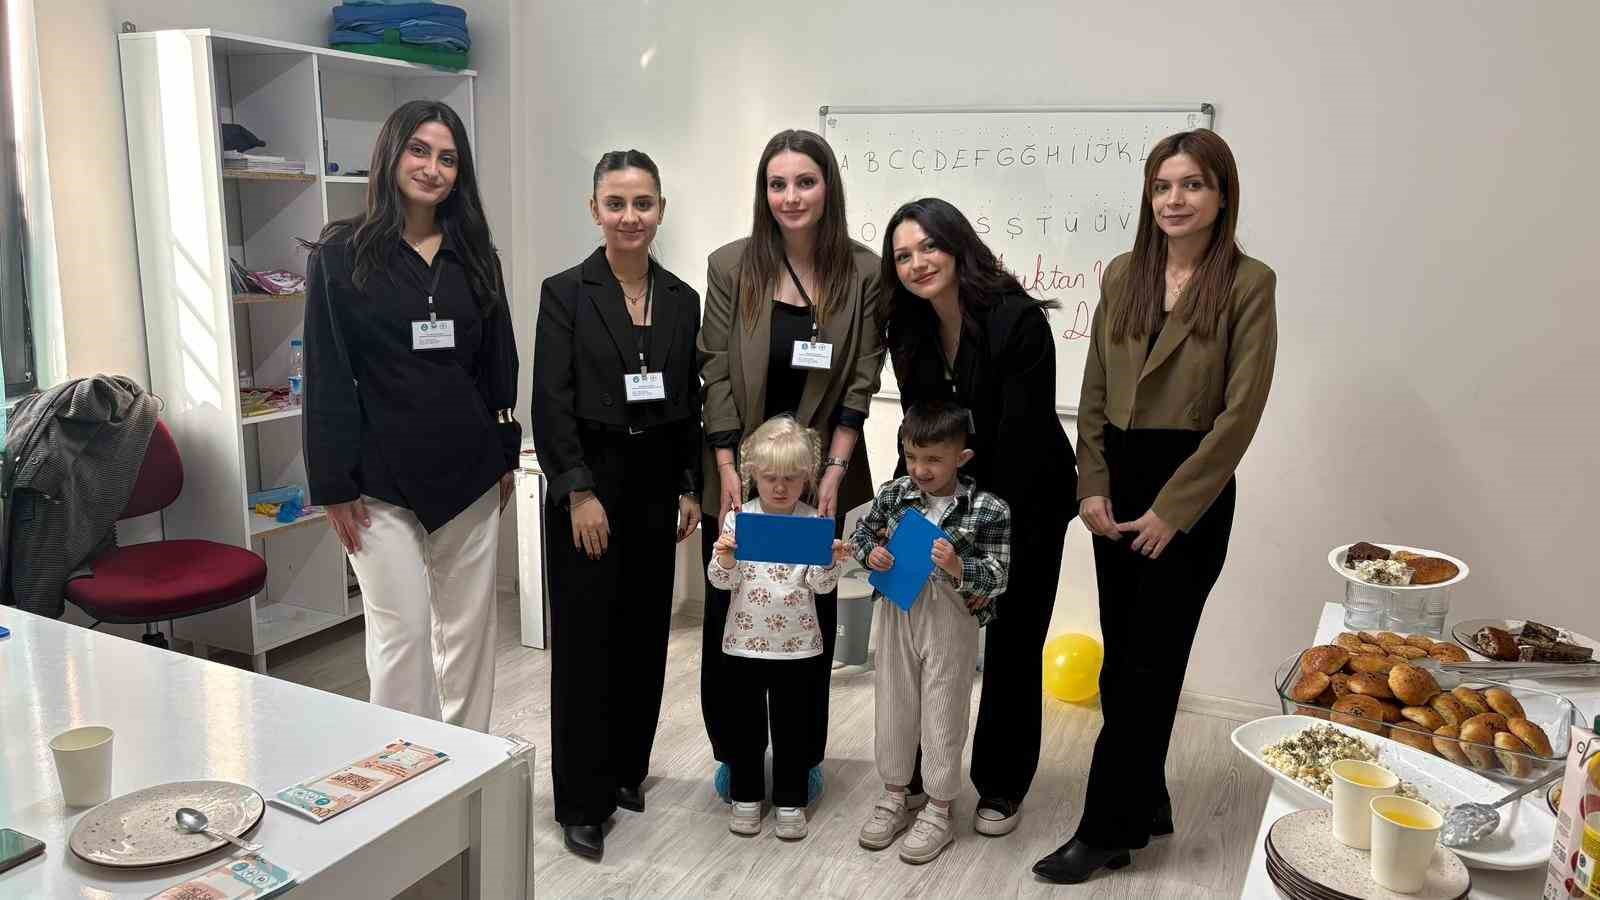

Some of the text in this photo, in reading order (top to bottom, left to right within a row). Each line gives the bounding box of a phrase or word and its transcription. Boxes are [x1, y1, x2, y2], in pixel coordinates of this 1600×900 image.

[840, 153, 848, 170] A
[863, 151, 880, 172] B
[888, 149, 904, 170] C
[912, 149, 926, 174] Ç
[933, 150, 947, 171] D
[952, 149, 969, 169] E
[974, 149, 992, 167] F
[996, 147, 1015, 166] G
[1020, 143, 1036, 166] Ğ
[1046, 145, 1060, 165] H
[1094, 142, 1113, 163] J
[1116, 140, 1132, 163] K
[861, 222, 877, 242] O
[976, 216, 991, 234] S
[1006, 217, 1024, 240] Ş
[1036, 216, 1053, 236] T
[1118, 212, 1131, 230] V
